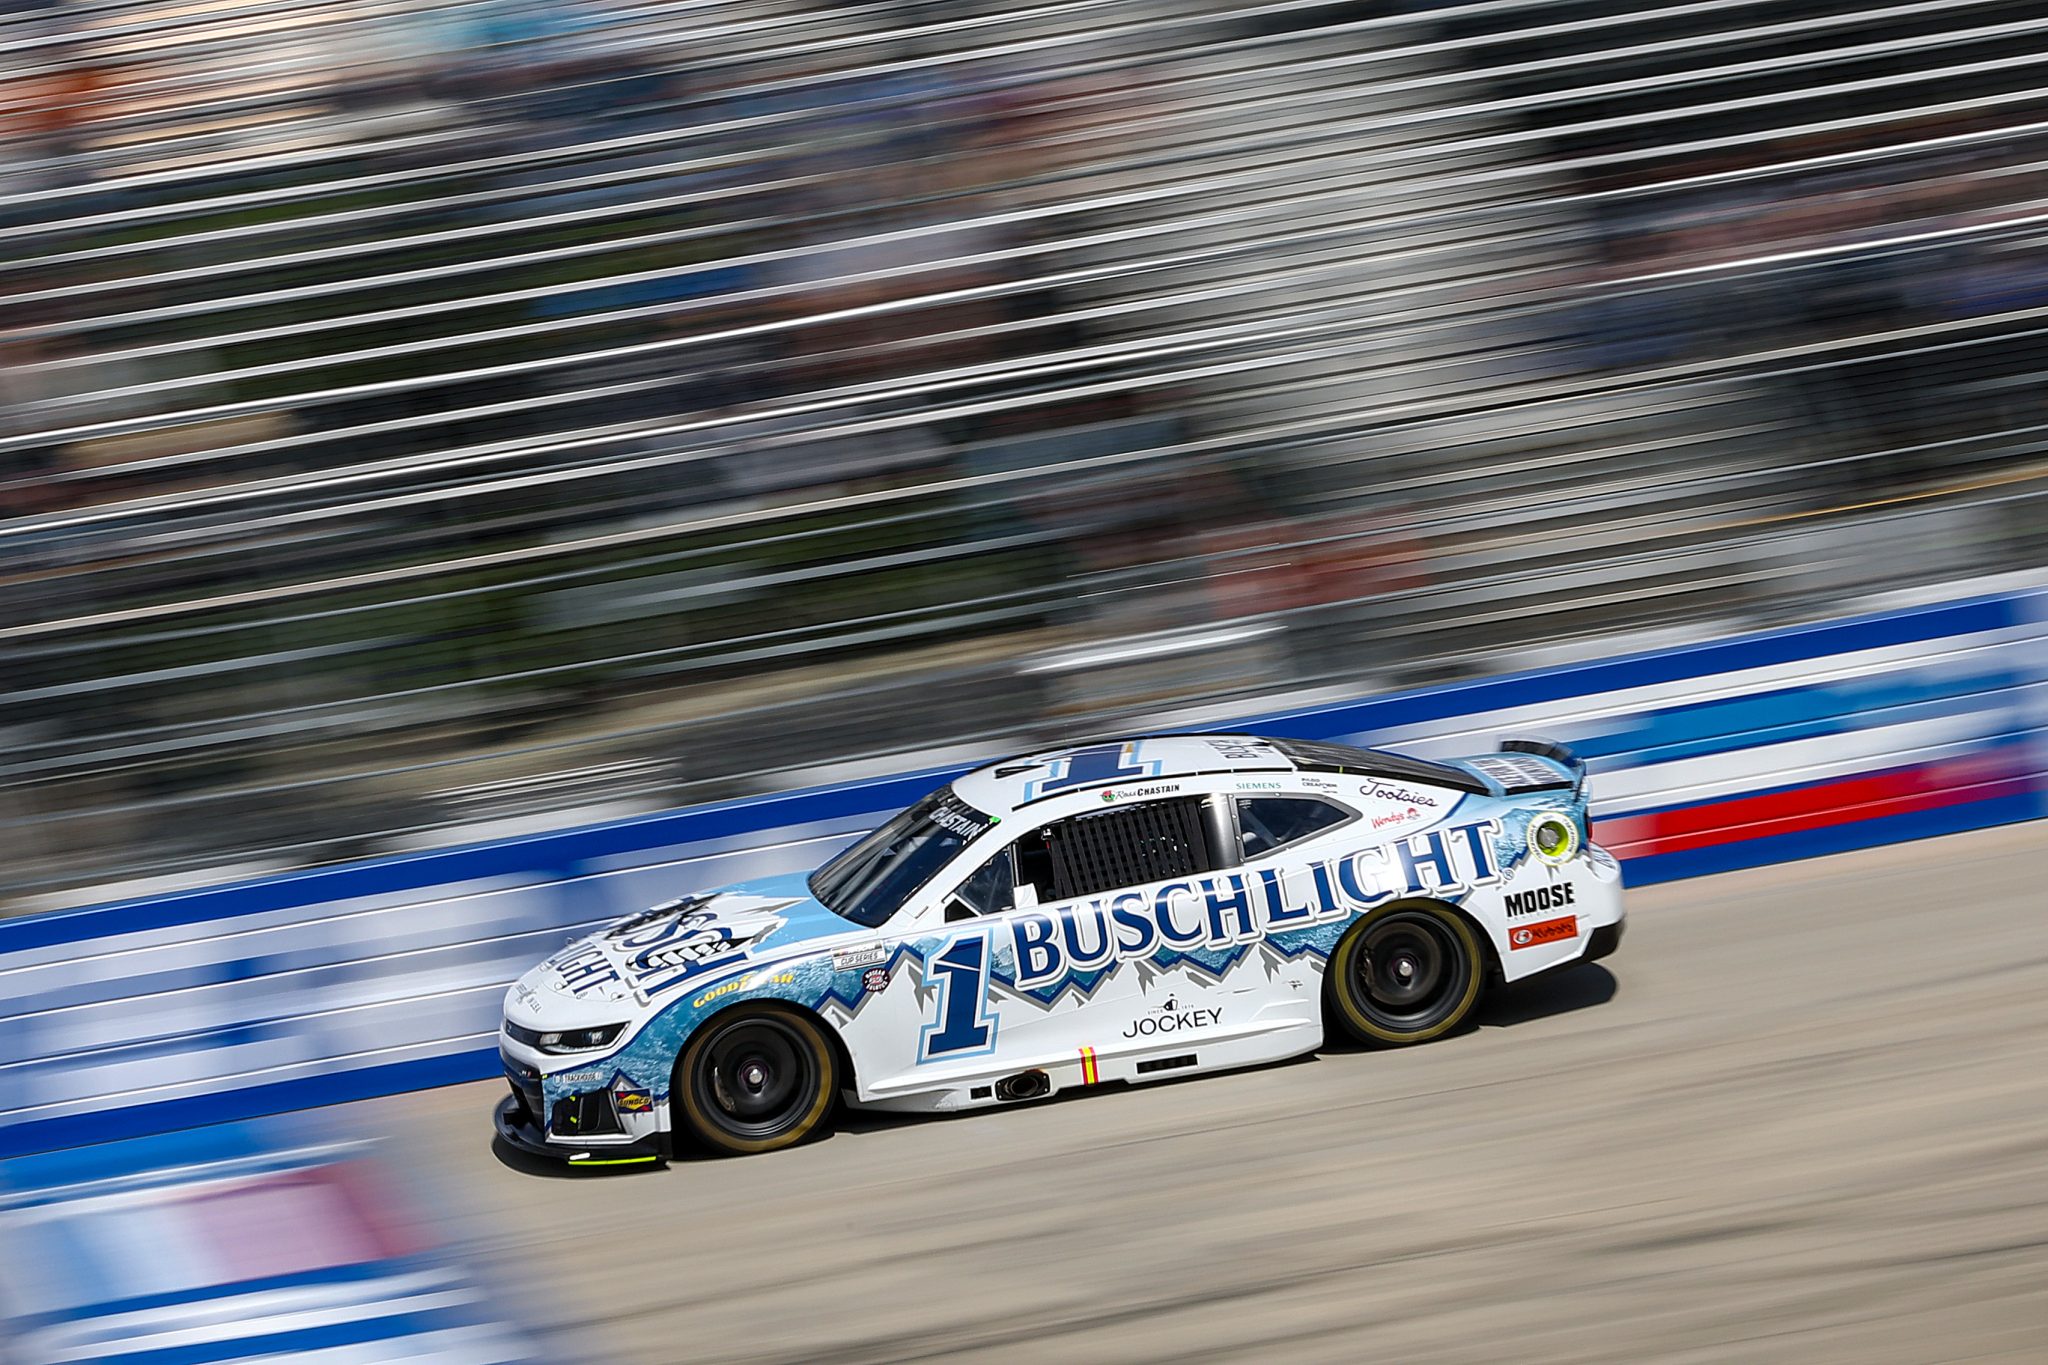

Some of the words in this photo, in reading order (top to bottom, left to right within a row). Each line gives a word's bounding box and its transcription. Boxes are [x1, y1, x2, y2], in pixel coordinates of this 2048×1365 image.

[1137, 784, 1180, 797] CHASTAIN
[1236, 782, 1281, 790] SIEMENS
[1359, 777, 1439, 807] Tootsies
[1504, 882, 1575, 918] MOOSE
[693, 973, 794, 1008] GOODYAR
[918, 929, 997, 1064] 1
[1123, 1007, 1223, 1038] JOCKEY
[617, 1096, 651, 1107] SUNOCO
